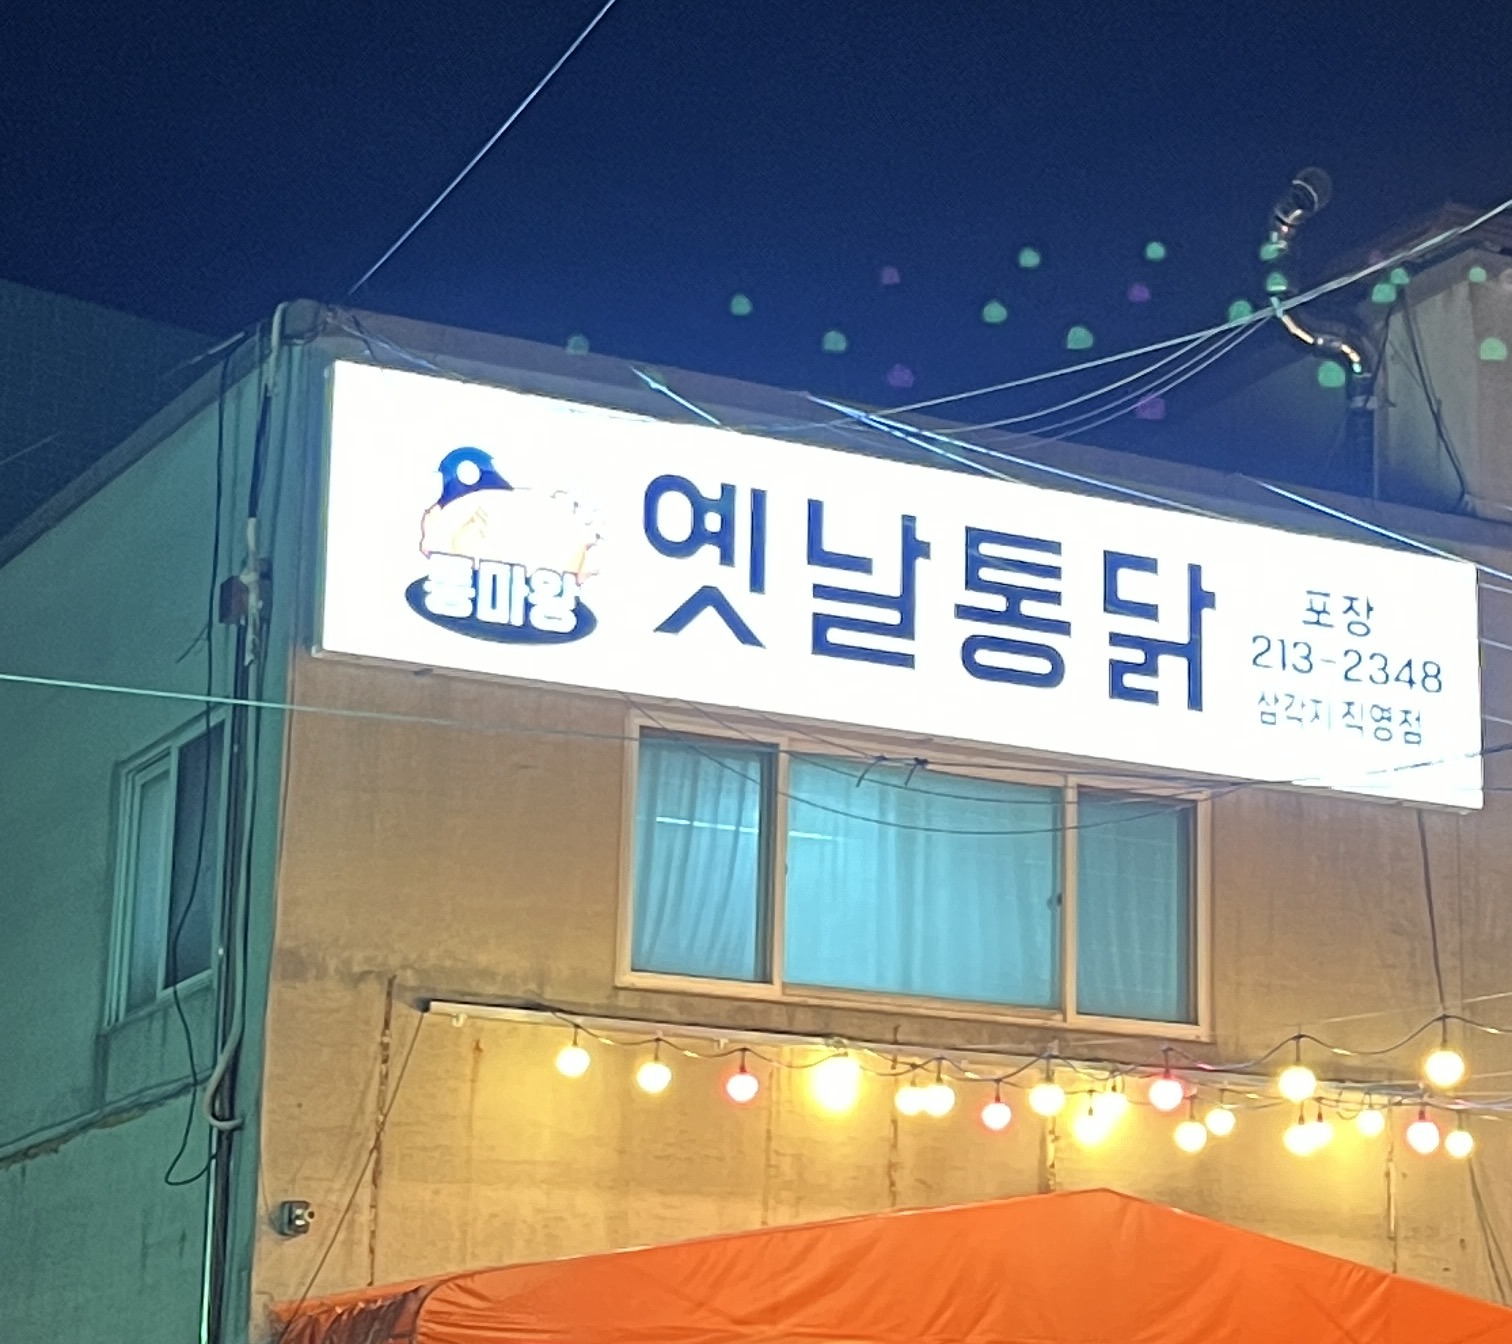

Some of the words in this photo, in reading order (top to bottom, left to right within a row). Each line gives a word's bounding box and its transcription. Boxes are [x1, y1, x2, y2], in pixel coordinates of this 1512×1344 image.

[643, 474, 1216, 712] 옛날통닭
[1302, 590, 1374, 638] 포장
[1252, 635, 1443, 693] 213-2348
[1258, 691, 1332, 732] 삼각지
[1342, 701, 1423, 746] 직영점
